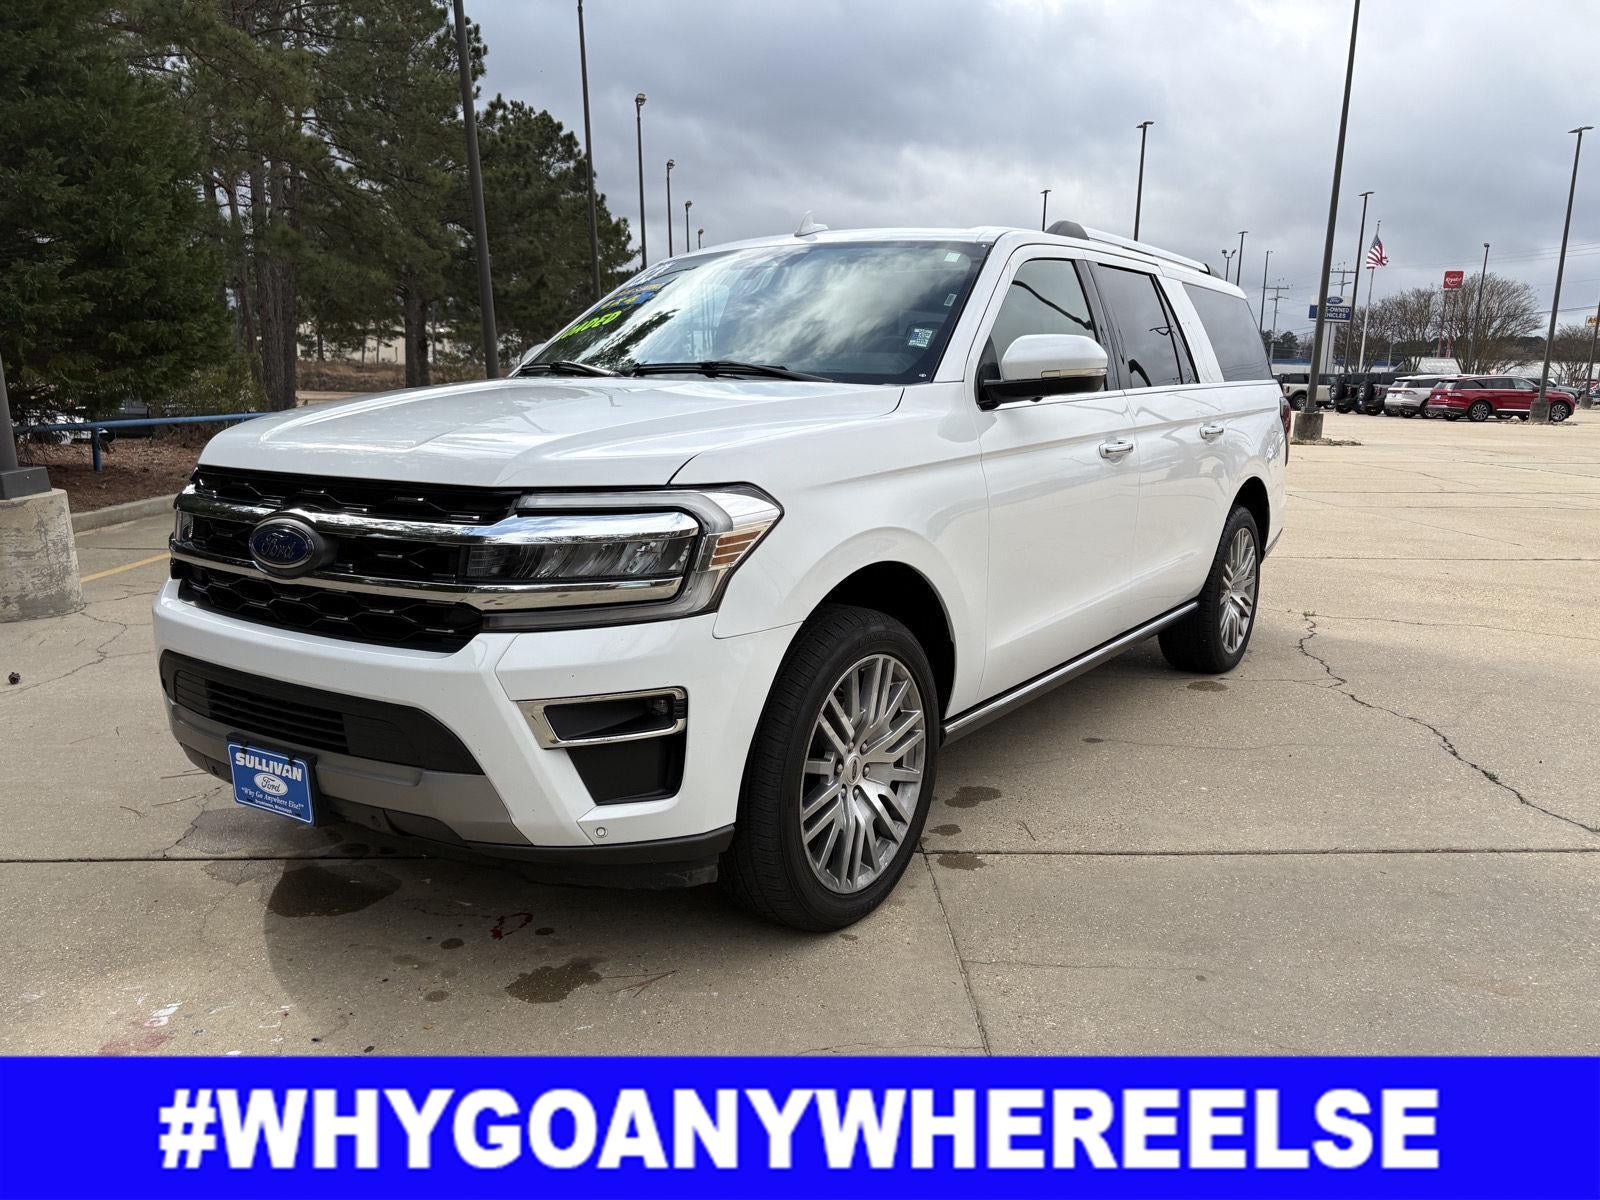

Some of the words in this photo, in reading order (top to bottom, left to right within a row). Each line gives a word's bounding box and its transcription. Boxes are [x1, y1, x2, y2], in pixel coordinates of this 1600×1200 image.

[261, 532, 297, 560] Ford
[235, 752, 302, 781] SULLIVAN
[261, 776, 281, 792] Ford
